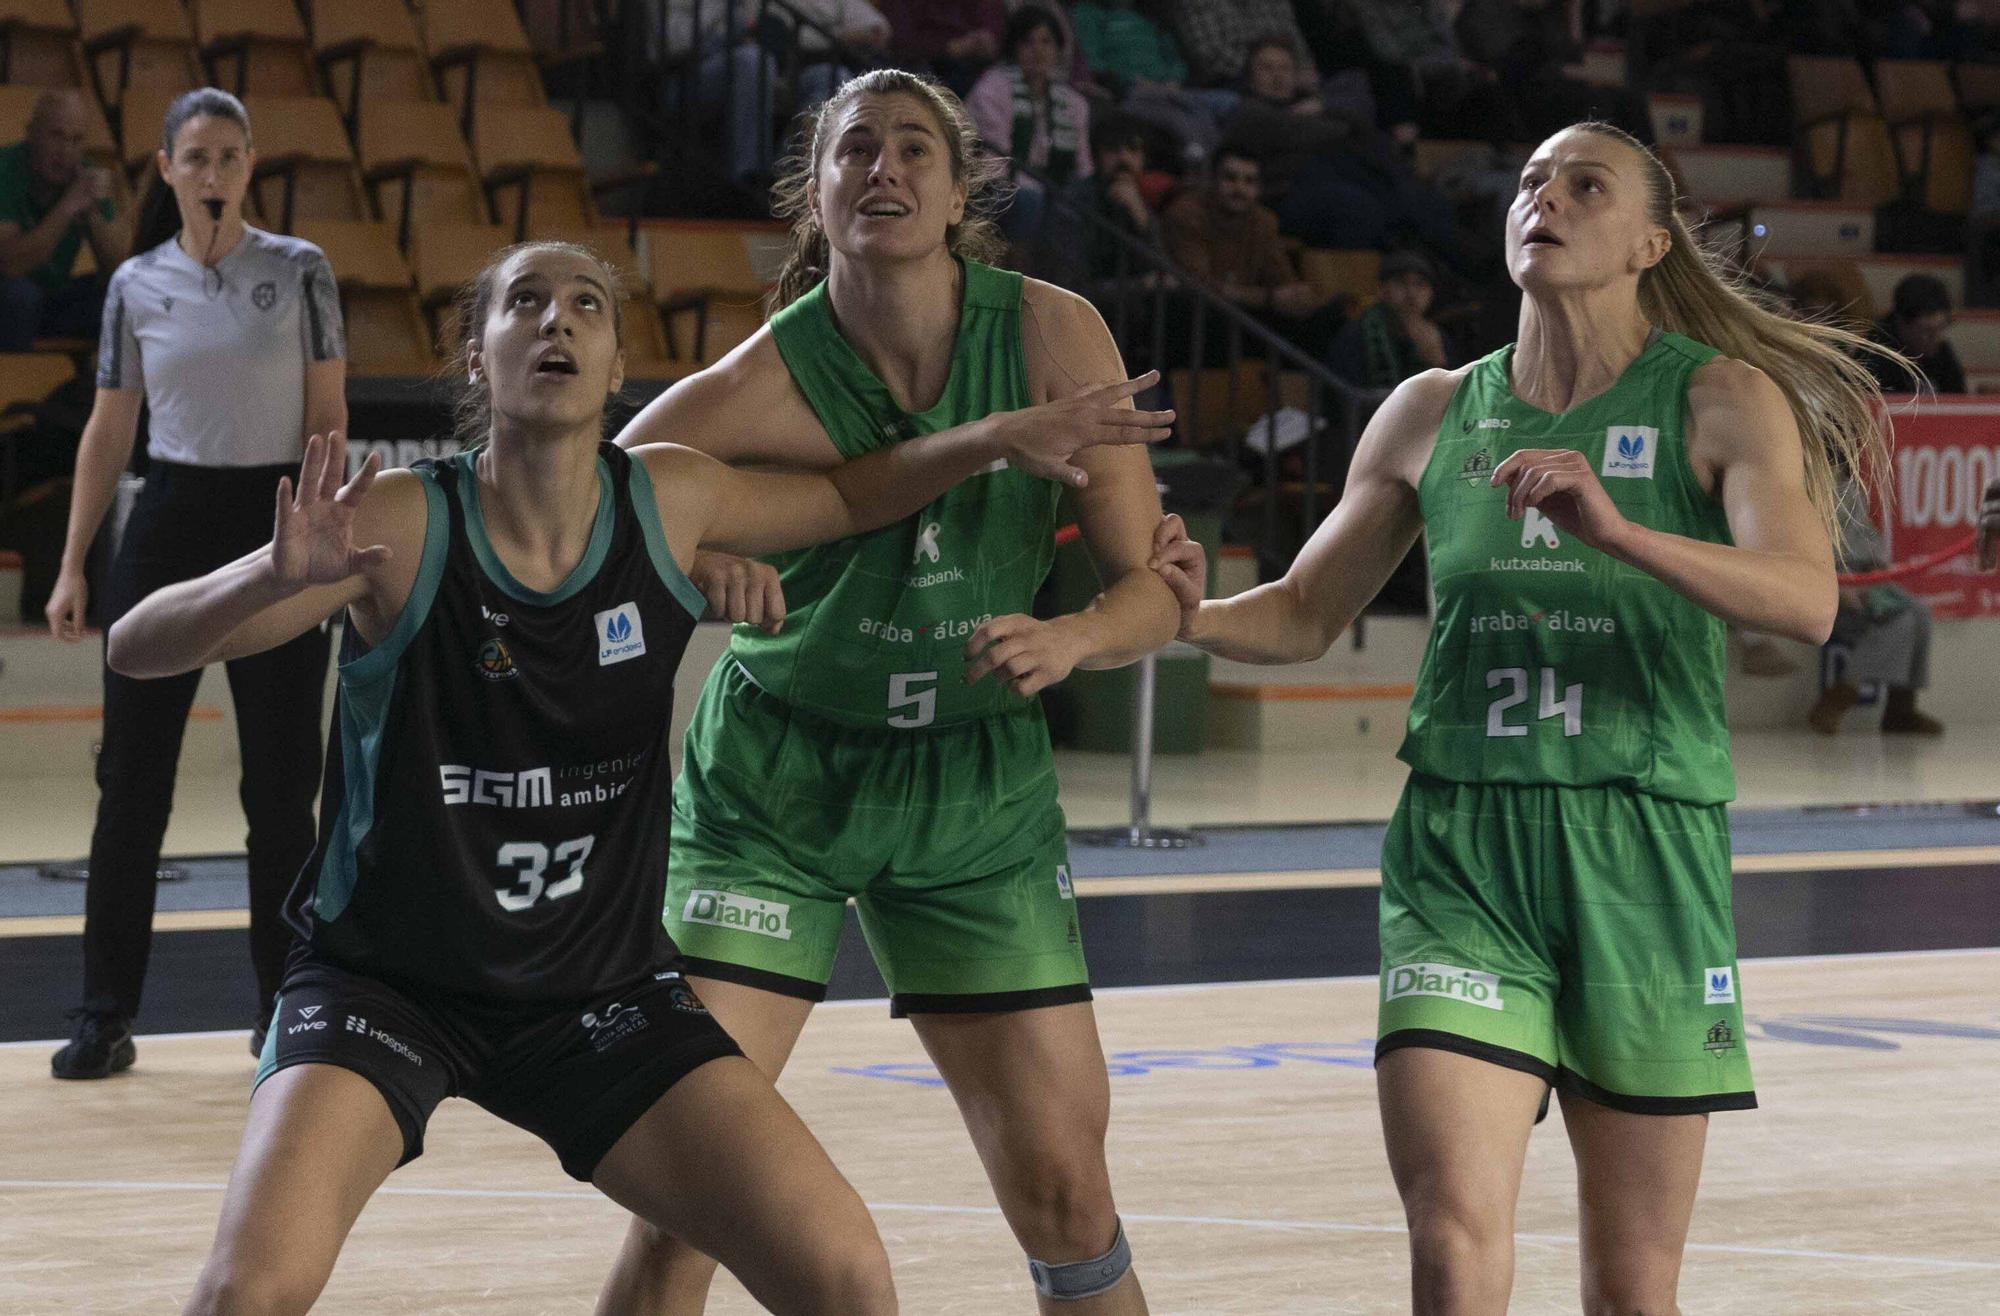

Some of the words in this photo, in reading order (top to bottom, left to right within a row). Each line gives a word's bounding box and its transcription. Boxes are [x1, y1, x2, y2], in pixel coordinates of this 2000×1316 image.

[1900, 446, 2000, 527] 1000
[909, 565, 965, 588] xabank
[1490, 556, 1586, 573] kutxabank
[1470, 609, 1529, 634] araba
[1548, 609, 1616, 634] álava
[886, 671, 938, 729] 5
[1485, 666, 1584, 737] 24
[439, 764, 553, 808] SGM
[690, 892, 782, 933] Diario
[1392, 966, 1489, 1002] Diario
[287, 1020, 328, 1035] vive
[369, 1027, 423, 1067] Hospiten
